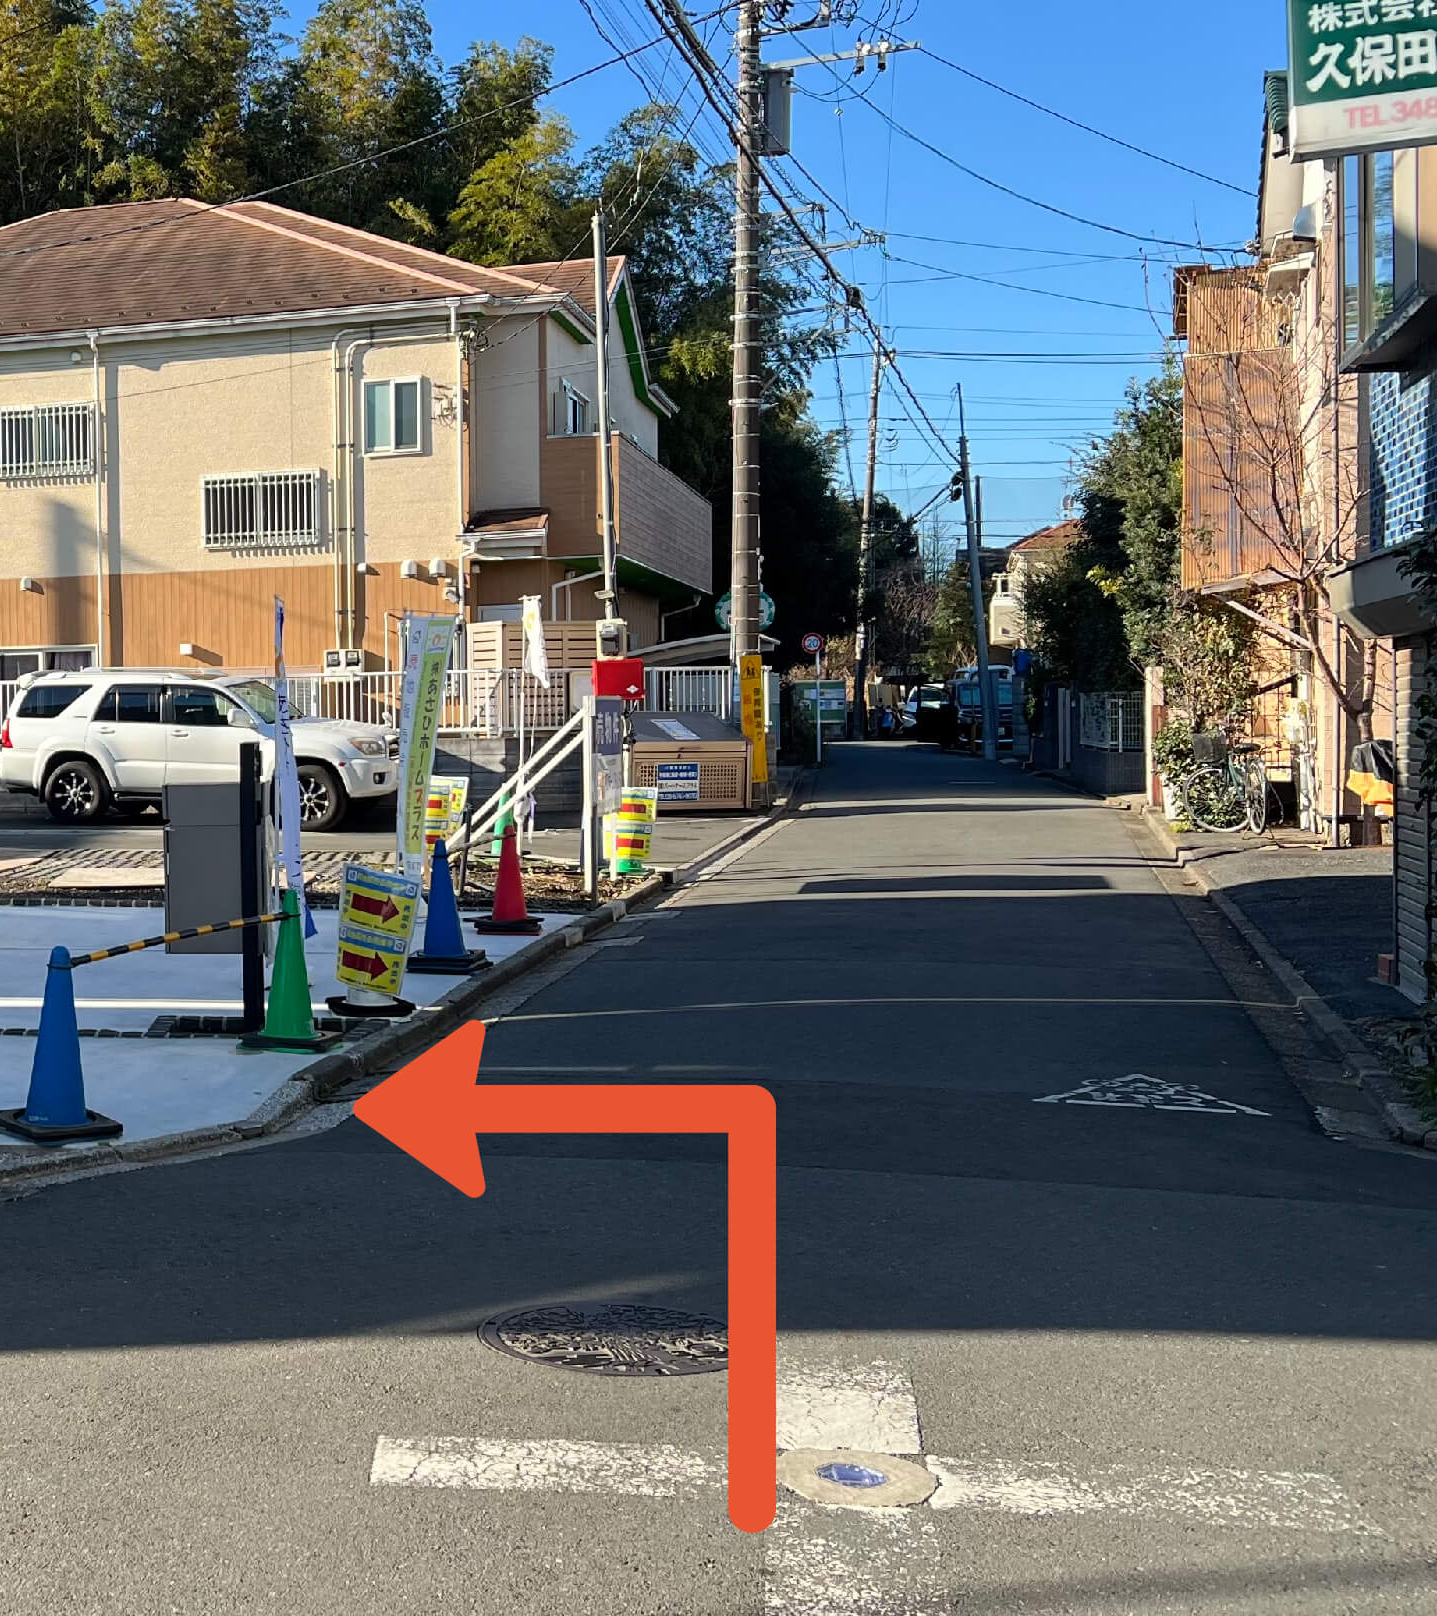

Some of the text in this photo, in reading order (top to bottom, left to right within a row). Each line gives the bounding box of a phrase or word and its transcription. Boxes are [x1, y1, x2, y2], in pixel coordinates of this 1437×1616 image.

[1306, 29, 1437, 92] 久保田
[1344, 104, 1389, 129] TEL
[807, 638, 819, 649] 20
